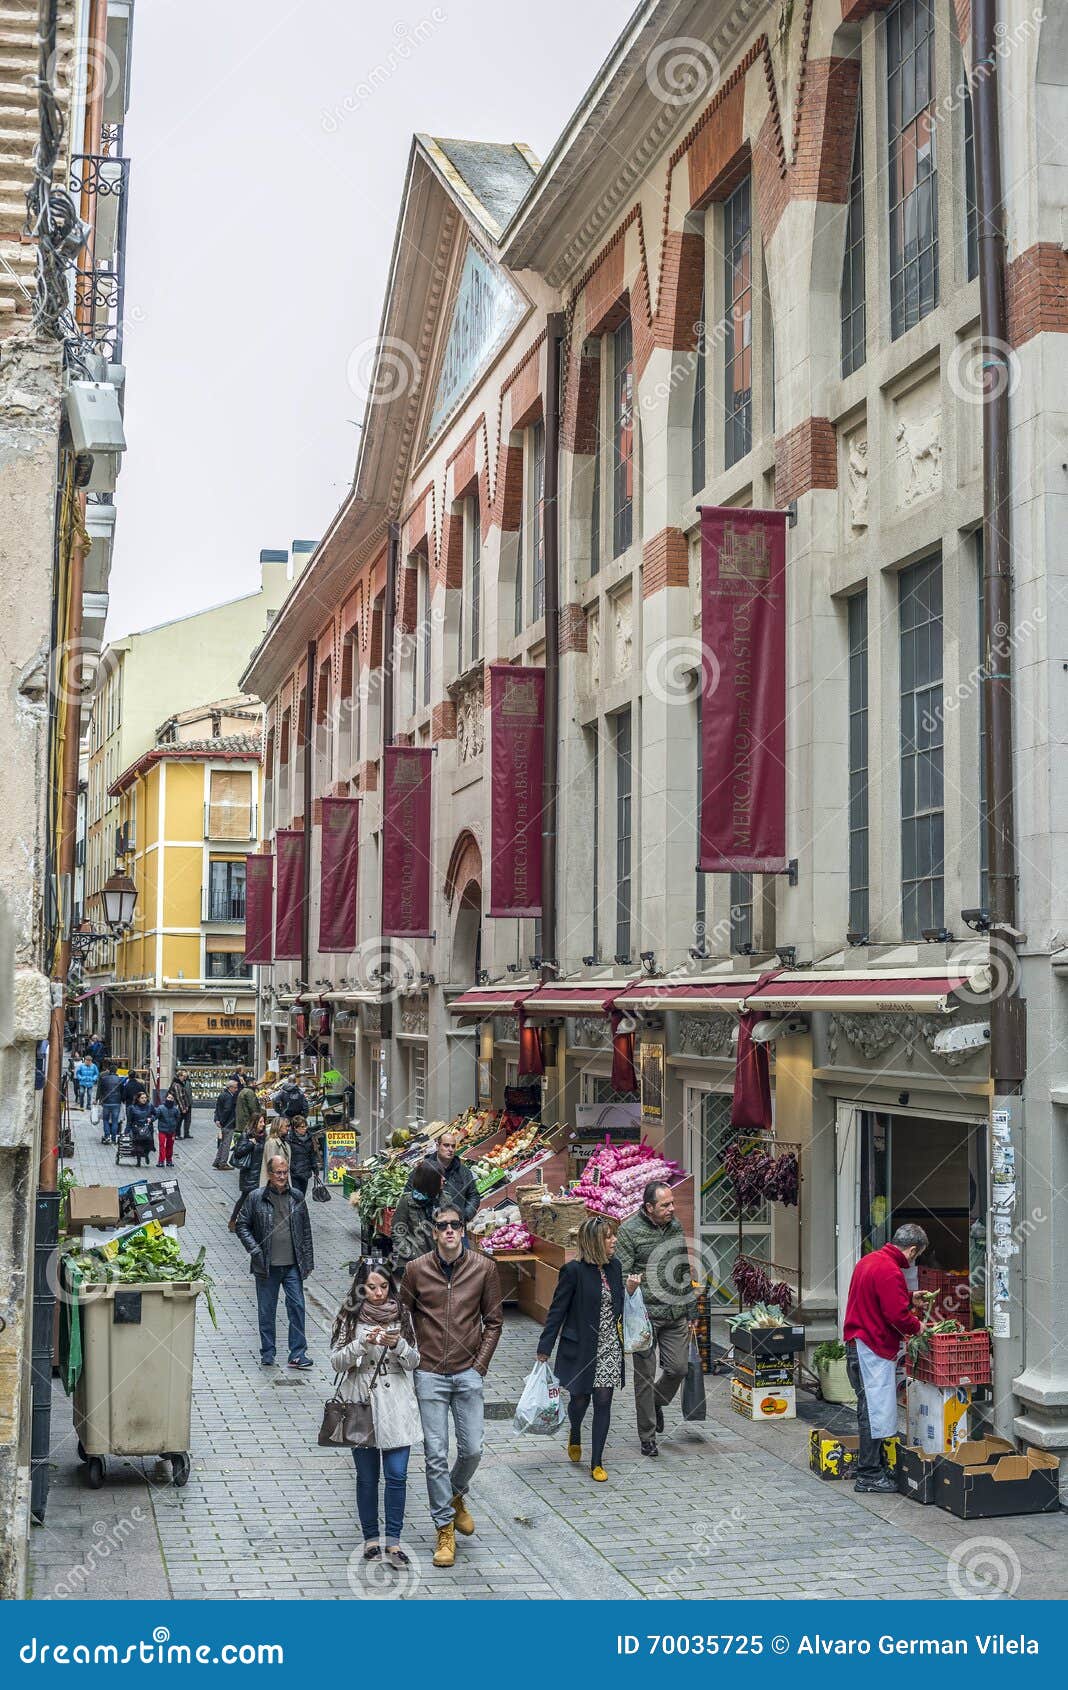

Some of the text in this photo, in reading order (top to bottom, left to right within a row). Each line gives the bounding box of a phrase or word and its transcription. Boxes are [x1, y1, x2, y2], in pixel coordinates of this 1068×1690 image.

[732, 604, 752, 700] ABASTOS
[513, 731, 529, 799] ABASTOS
[732, 734, 752, 849] MERCADO
[513, 821, 529, 906] MERCADO
[327, 1132, 355, 1140] OFERTA
